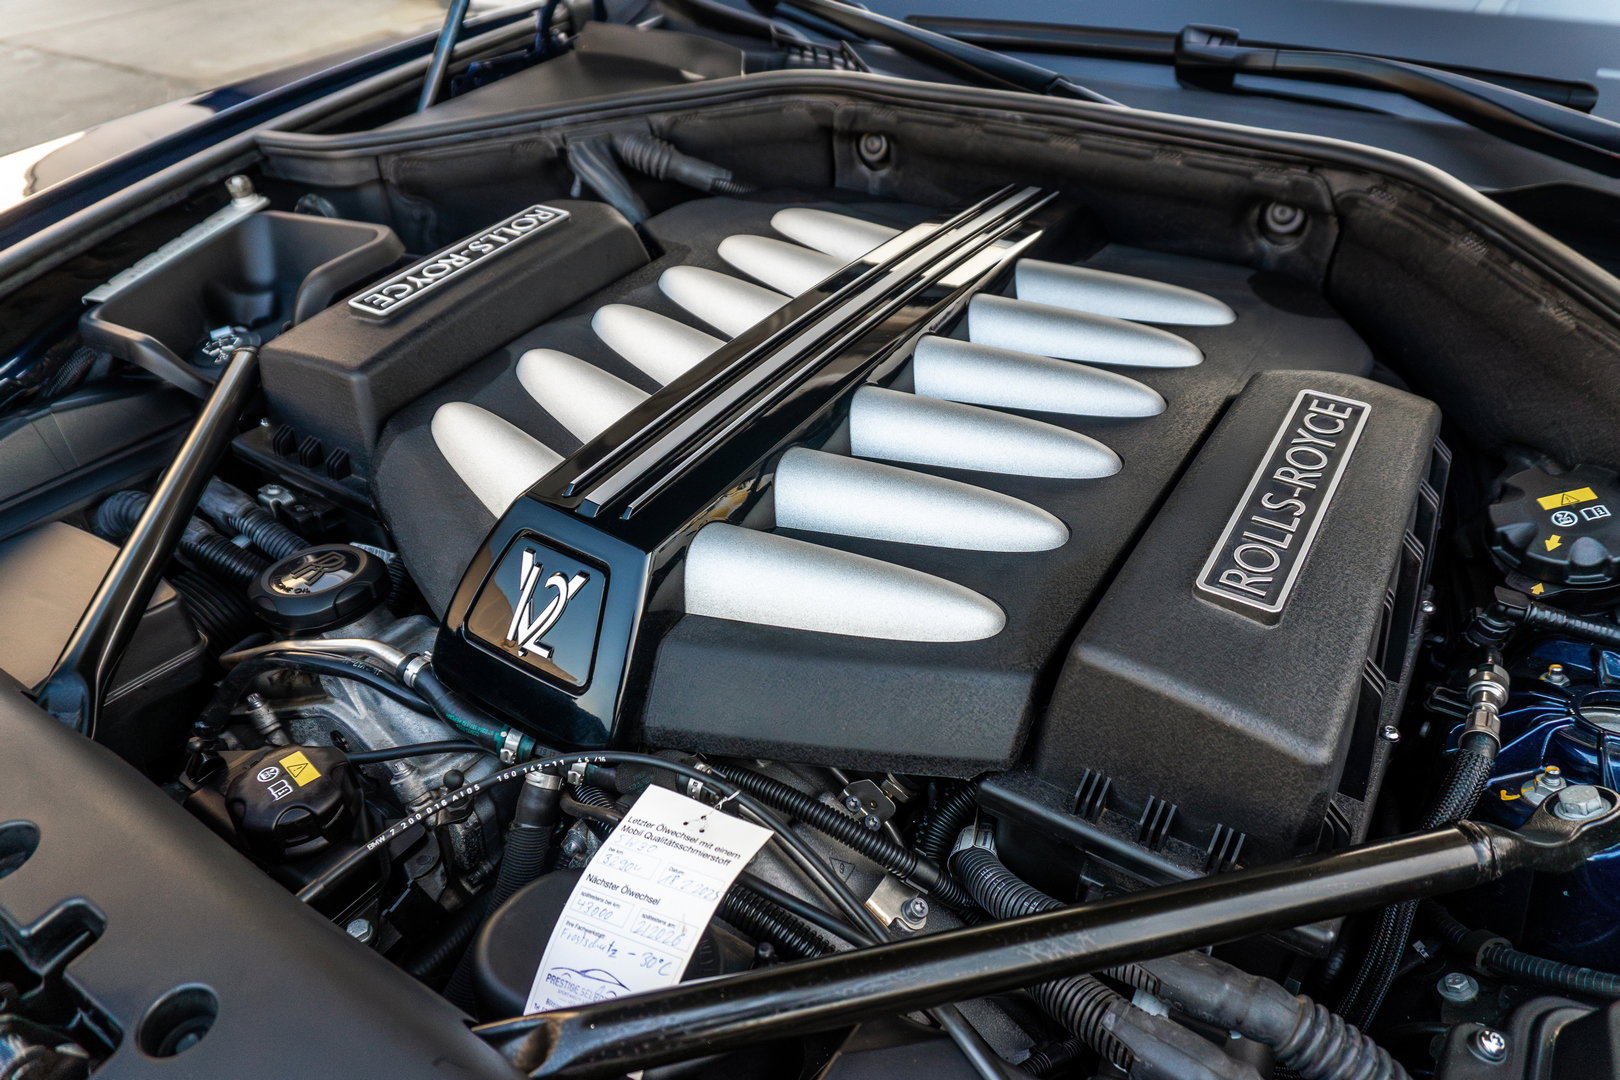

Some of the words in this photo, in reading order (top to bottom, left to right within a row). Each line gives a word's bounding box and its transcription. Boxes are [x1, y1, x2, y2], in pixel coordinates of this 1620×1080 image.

[364, 209, 555, 308] ROLLS-ROYCE
[1218, 398, 1354, 598] ROLLS-ROYCE
[366, 835, 386, 851] BMW
[400, 813, 422, 830] 200
[426, 799, 448, 814] 016
[496, 771, 517, 782] 160
[621, 824, 644, 840] Mobil
[643, 830, 733, 866] Qualitätsschmierstoff
[627, 815, 655, 830] Letzter
[655, 822, 700, 843] Ölwechsel
[700, 838, 714, 849] mit
[714, 844, 741, 859] einem
[586, 873, 620, 892] Nächster
[620, 884, 661, 906] Ölwechsel
[545, 973, 580, 994] PRESTIGE
